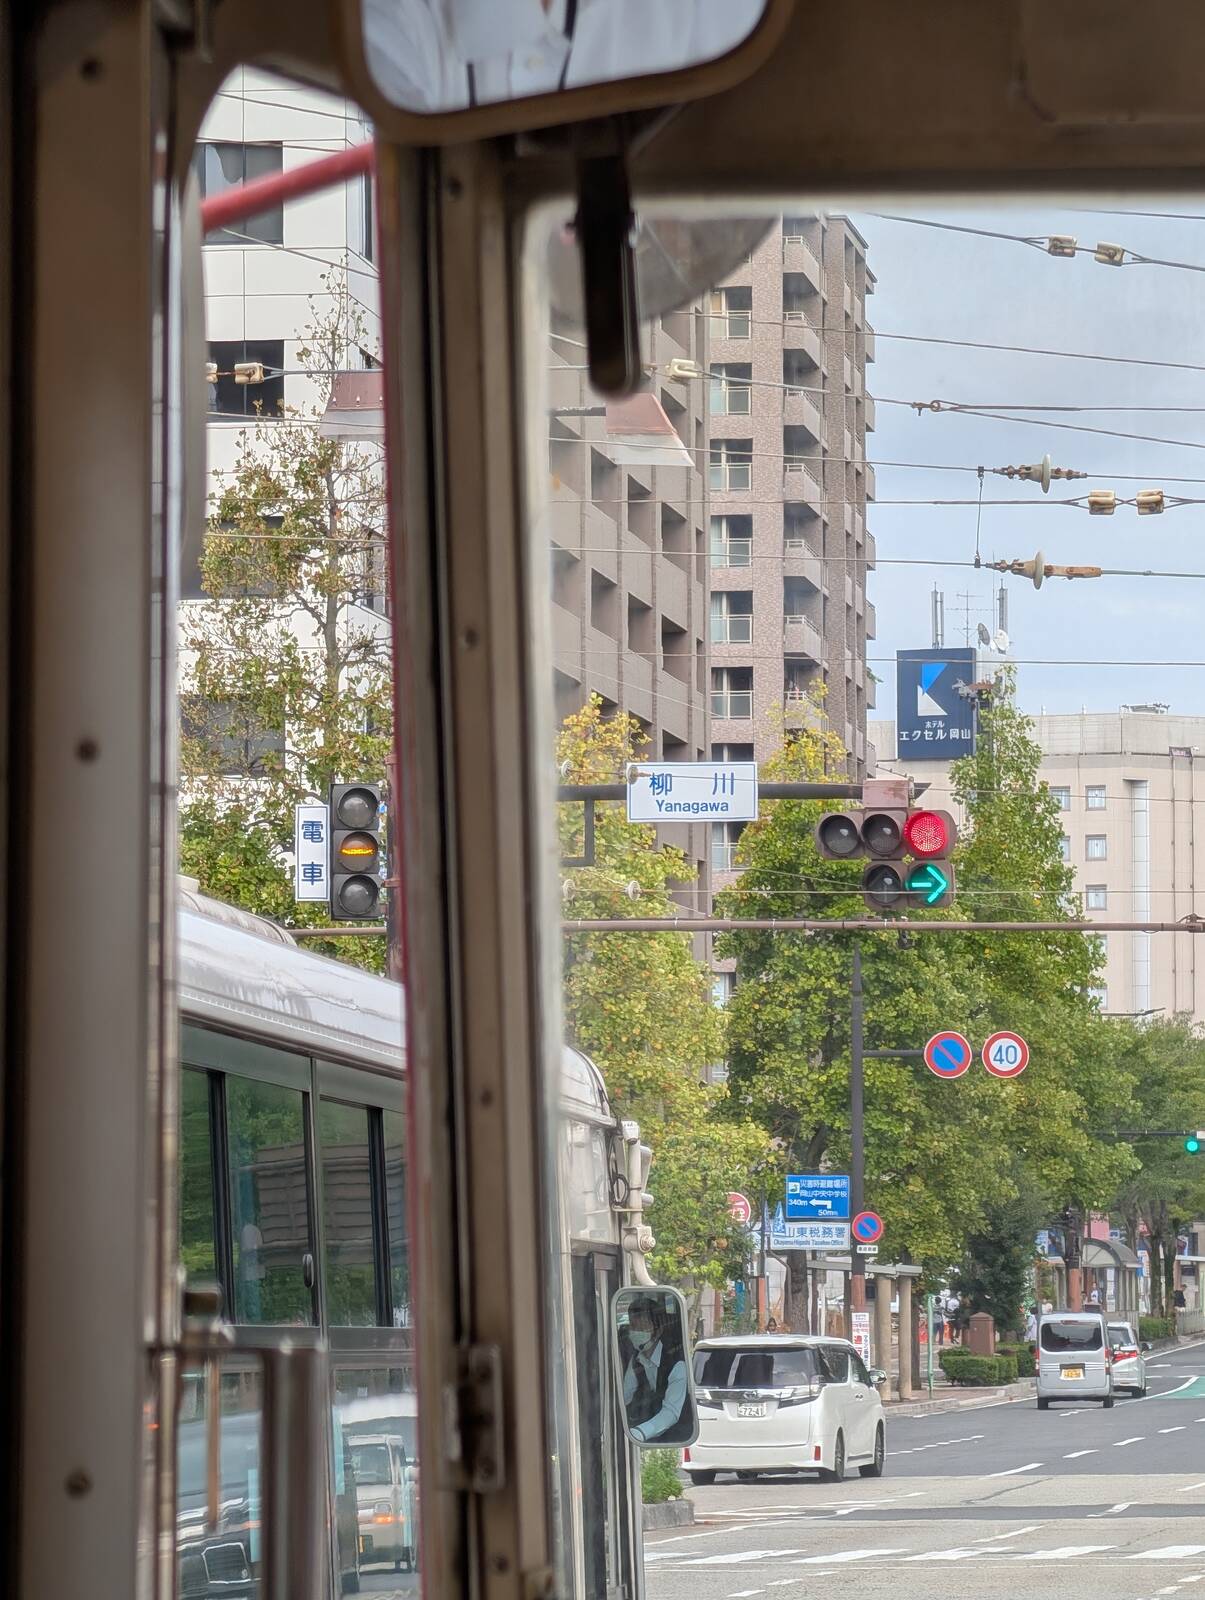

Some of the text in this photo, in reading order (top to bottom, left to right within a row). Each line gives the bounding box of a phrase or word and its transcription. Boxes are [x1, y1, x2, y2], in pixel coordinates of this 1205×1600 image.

[925, 720, 945, 729] ホテル
[899, 728, 971, 741] エクセル岡山
[649, 772, 735, 796] 柳川
[656, 800, 729, 814] Yanagawa
[301, 820, 324, 886] 電車
[993, 1044, 1018, 1065] 40
